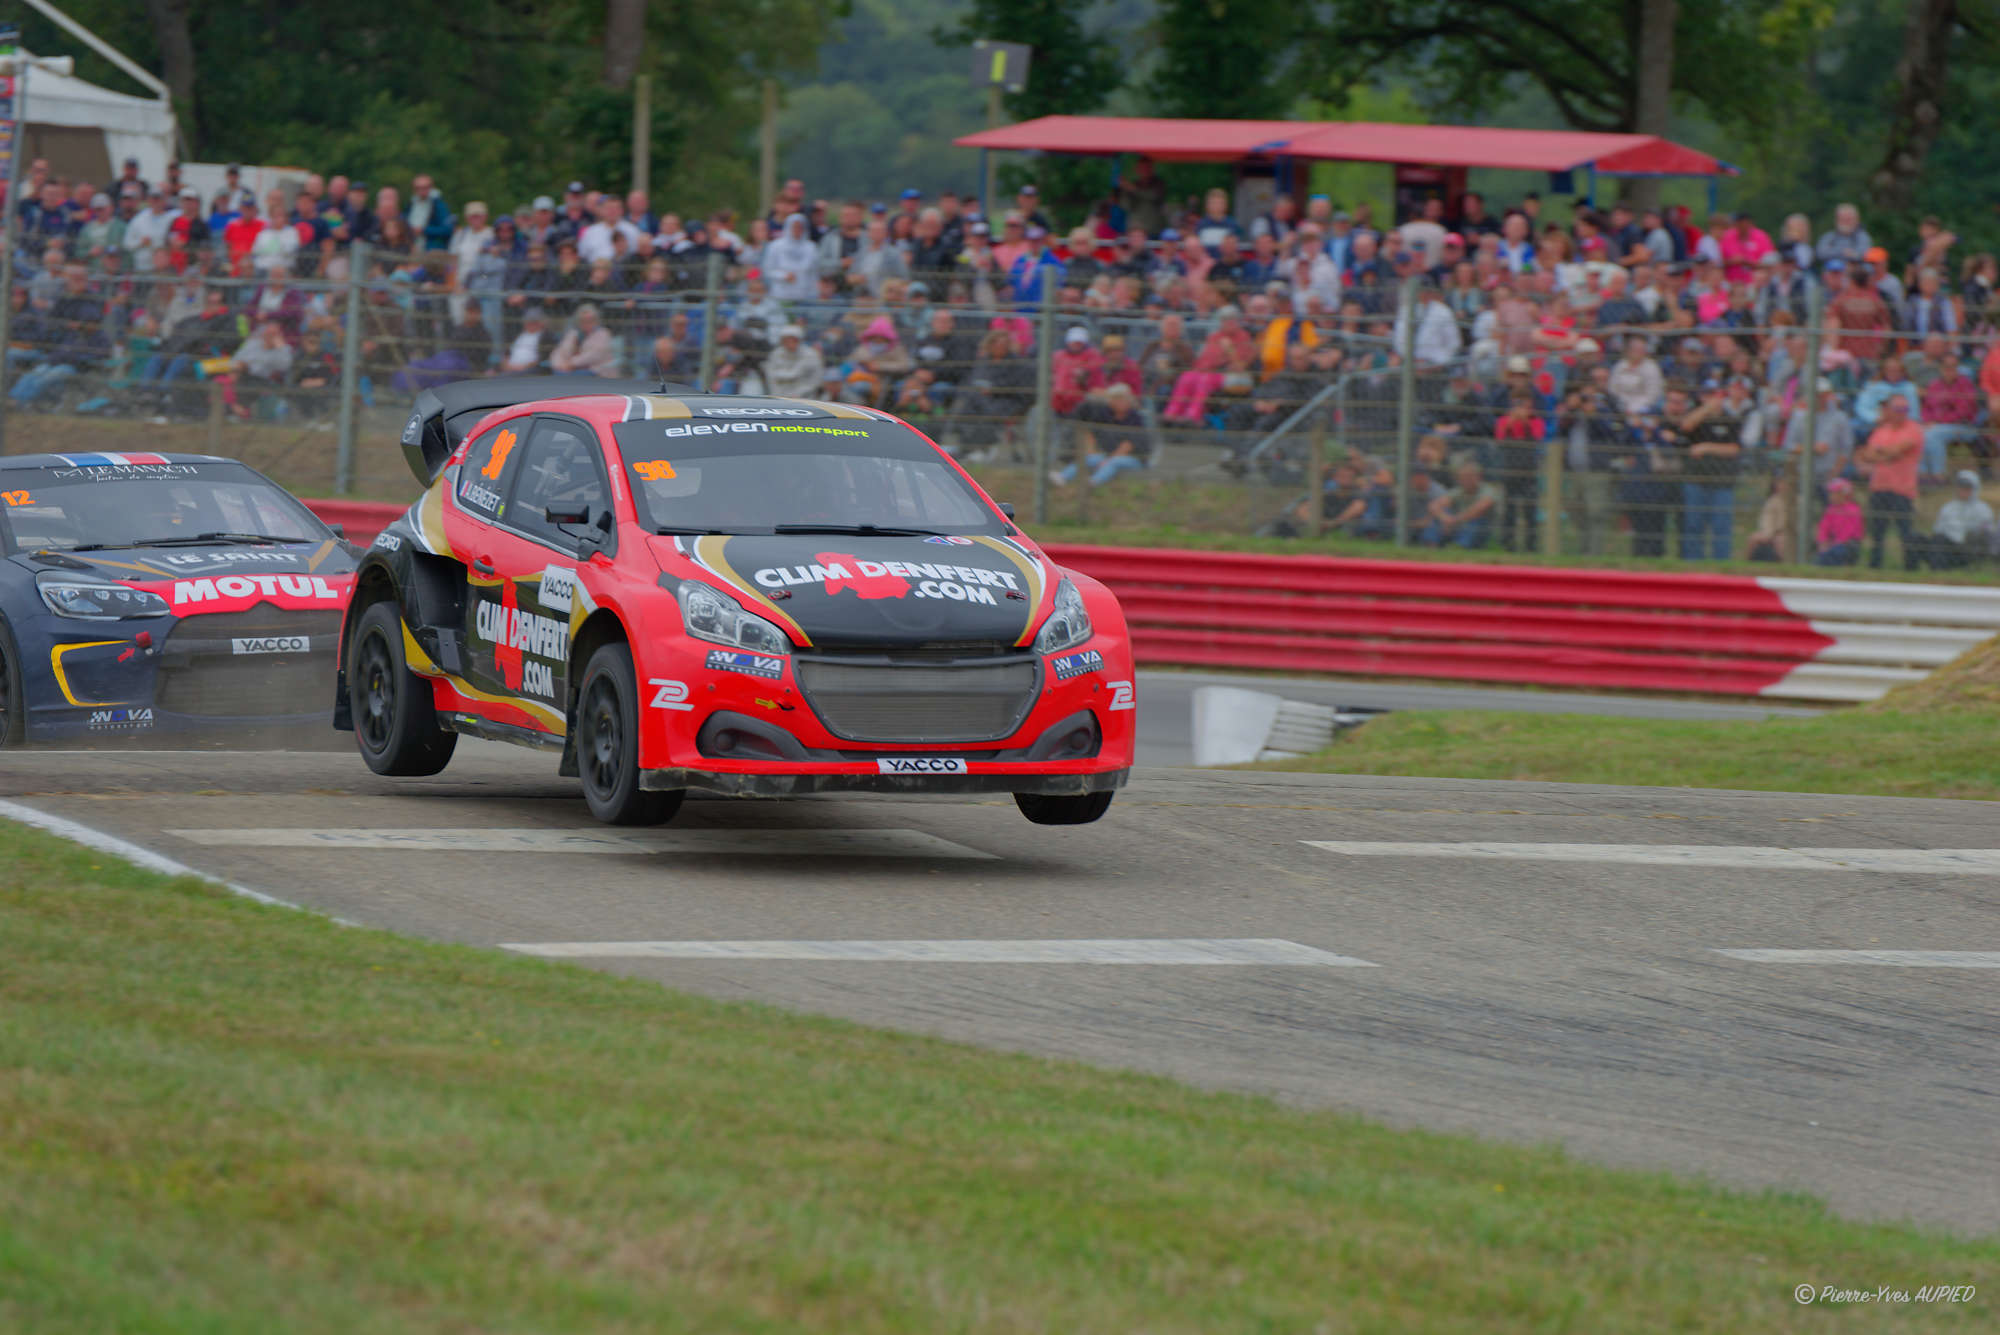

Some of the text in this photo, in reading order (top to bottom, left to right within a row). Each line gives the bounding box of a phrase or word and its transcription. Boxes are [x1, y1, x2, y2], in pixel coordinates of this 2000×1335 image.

[665, 422, 870, 438] eleven motorsport
[632, 460, 677, 480] 98
[0, 490, 36, 506] 12
[754, 561, 1019, 590] CLIM DENFERT
[174, 576, 338, 605] MOTUL
[545, 576, 574, 600] YACCO
[914, 580, 998, 605] .COM
[241, 638, 303, 652] YACCO
[523, 660, 554, 698] .COM
[887, 759, 958, 771] YACCO
